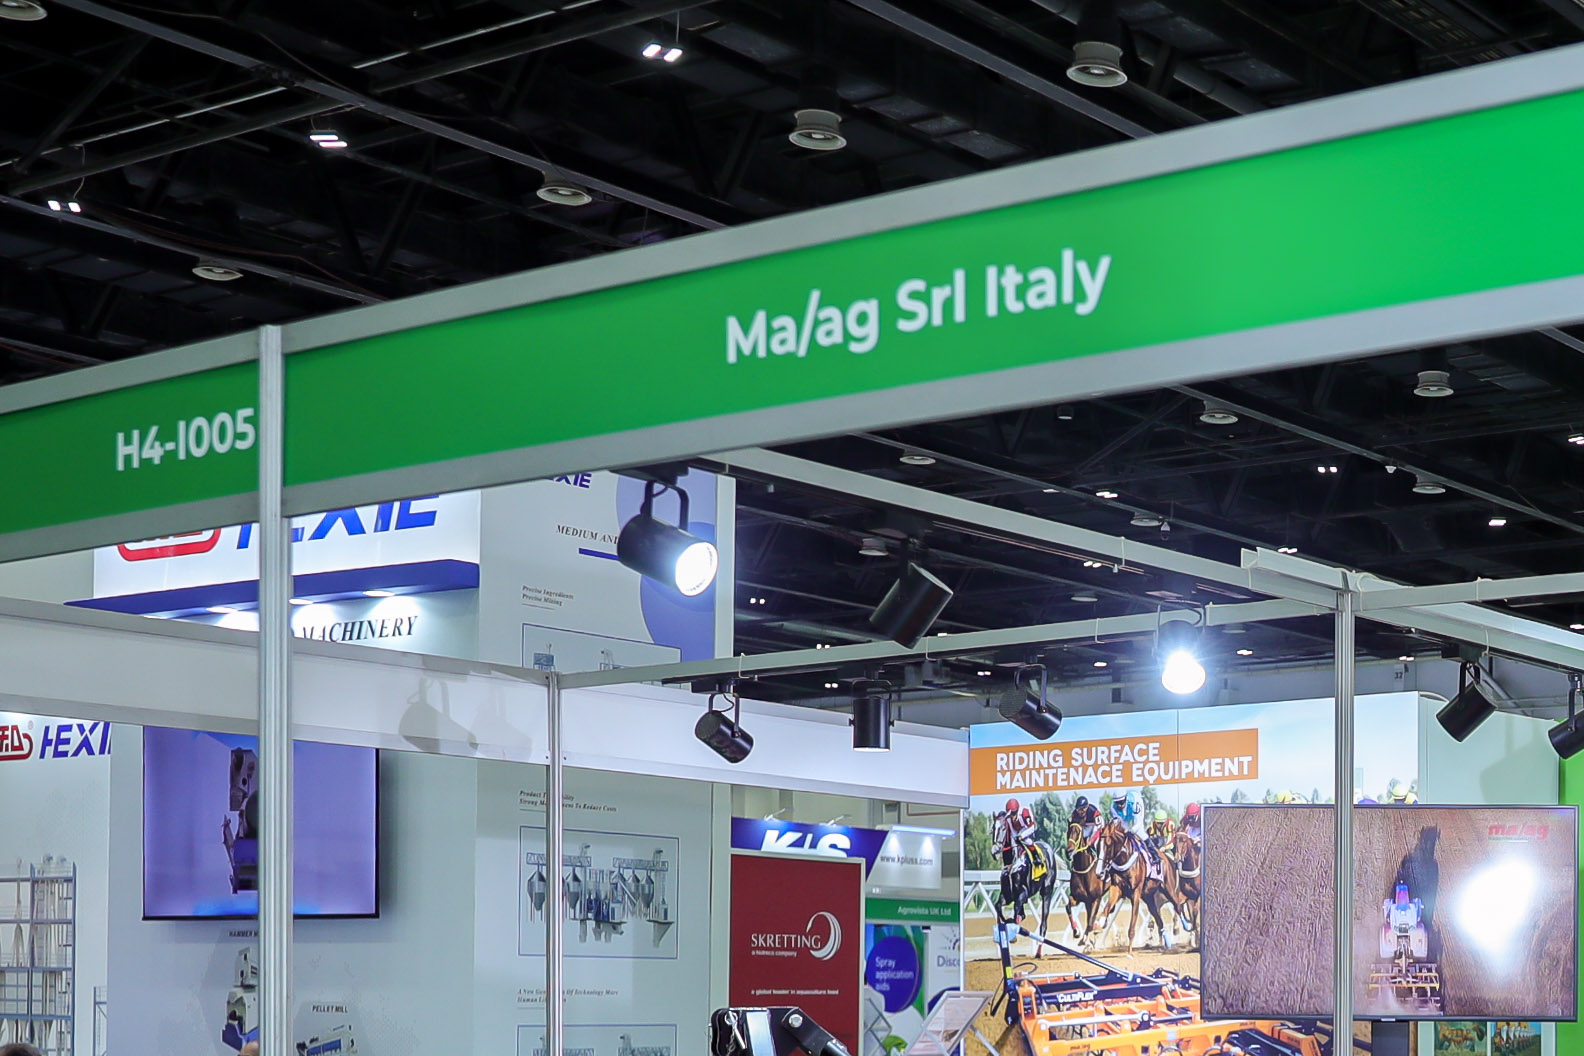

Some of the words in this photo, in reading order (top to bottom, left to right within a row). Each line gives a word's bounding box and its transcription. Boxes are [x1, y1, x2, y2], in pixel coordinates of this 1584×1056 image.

[726, 288, 880, 364] Ma/ag
[896, 268, 966, 332] Srl
[985, 247, 1112, 316] Italy
[556, 525, 598, 541] MEDIUM
[39, 721, 111, 759] HEXI
[996, 750, 1063, 771] RIDING
[1071, 742, 1160, 766] SURFACE
[996, 764, 1123, 790] MAINTENACE
[1131, 756, 1253, 784] EQUIPMENT
[880, 854, 933, 866] www.kpluss.com
[940, 907, 951, 916] Ltd
[751, 933, 821, 949] SKRETTING
[875, 956, 895, 969] Spray
[875, 969, 914, 980] application
[875, 980, 890, 991] aids
[755, 989, 772, 997] global
